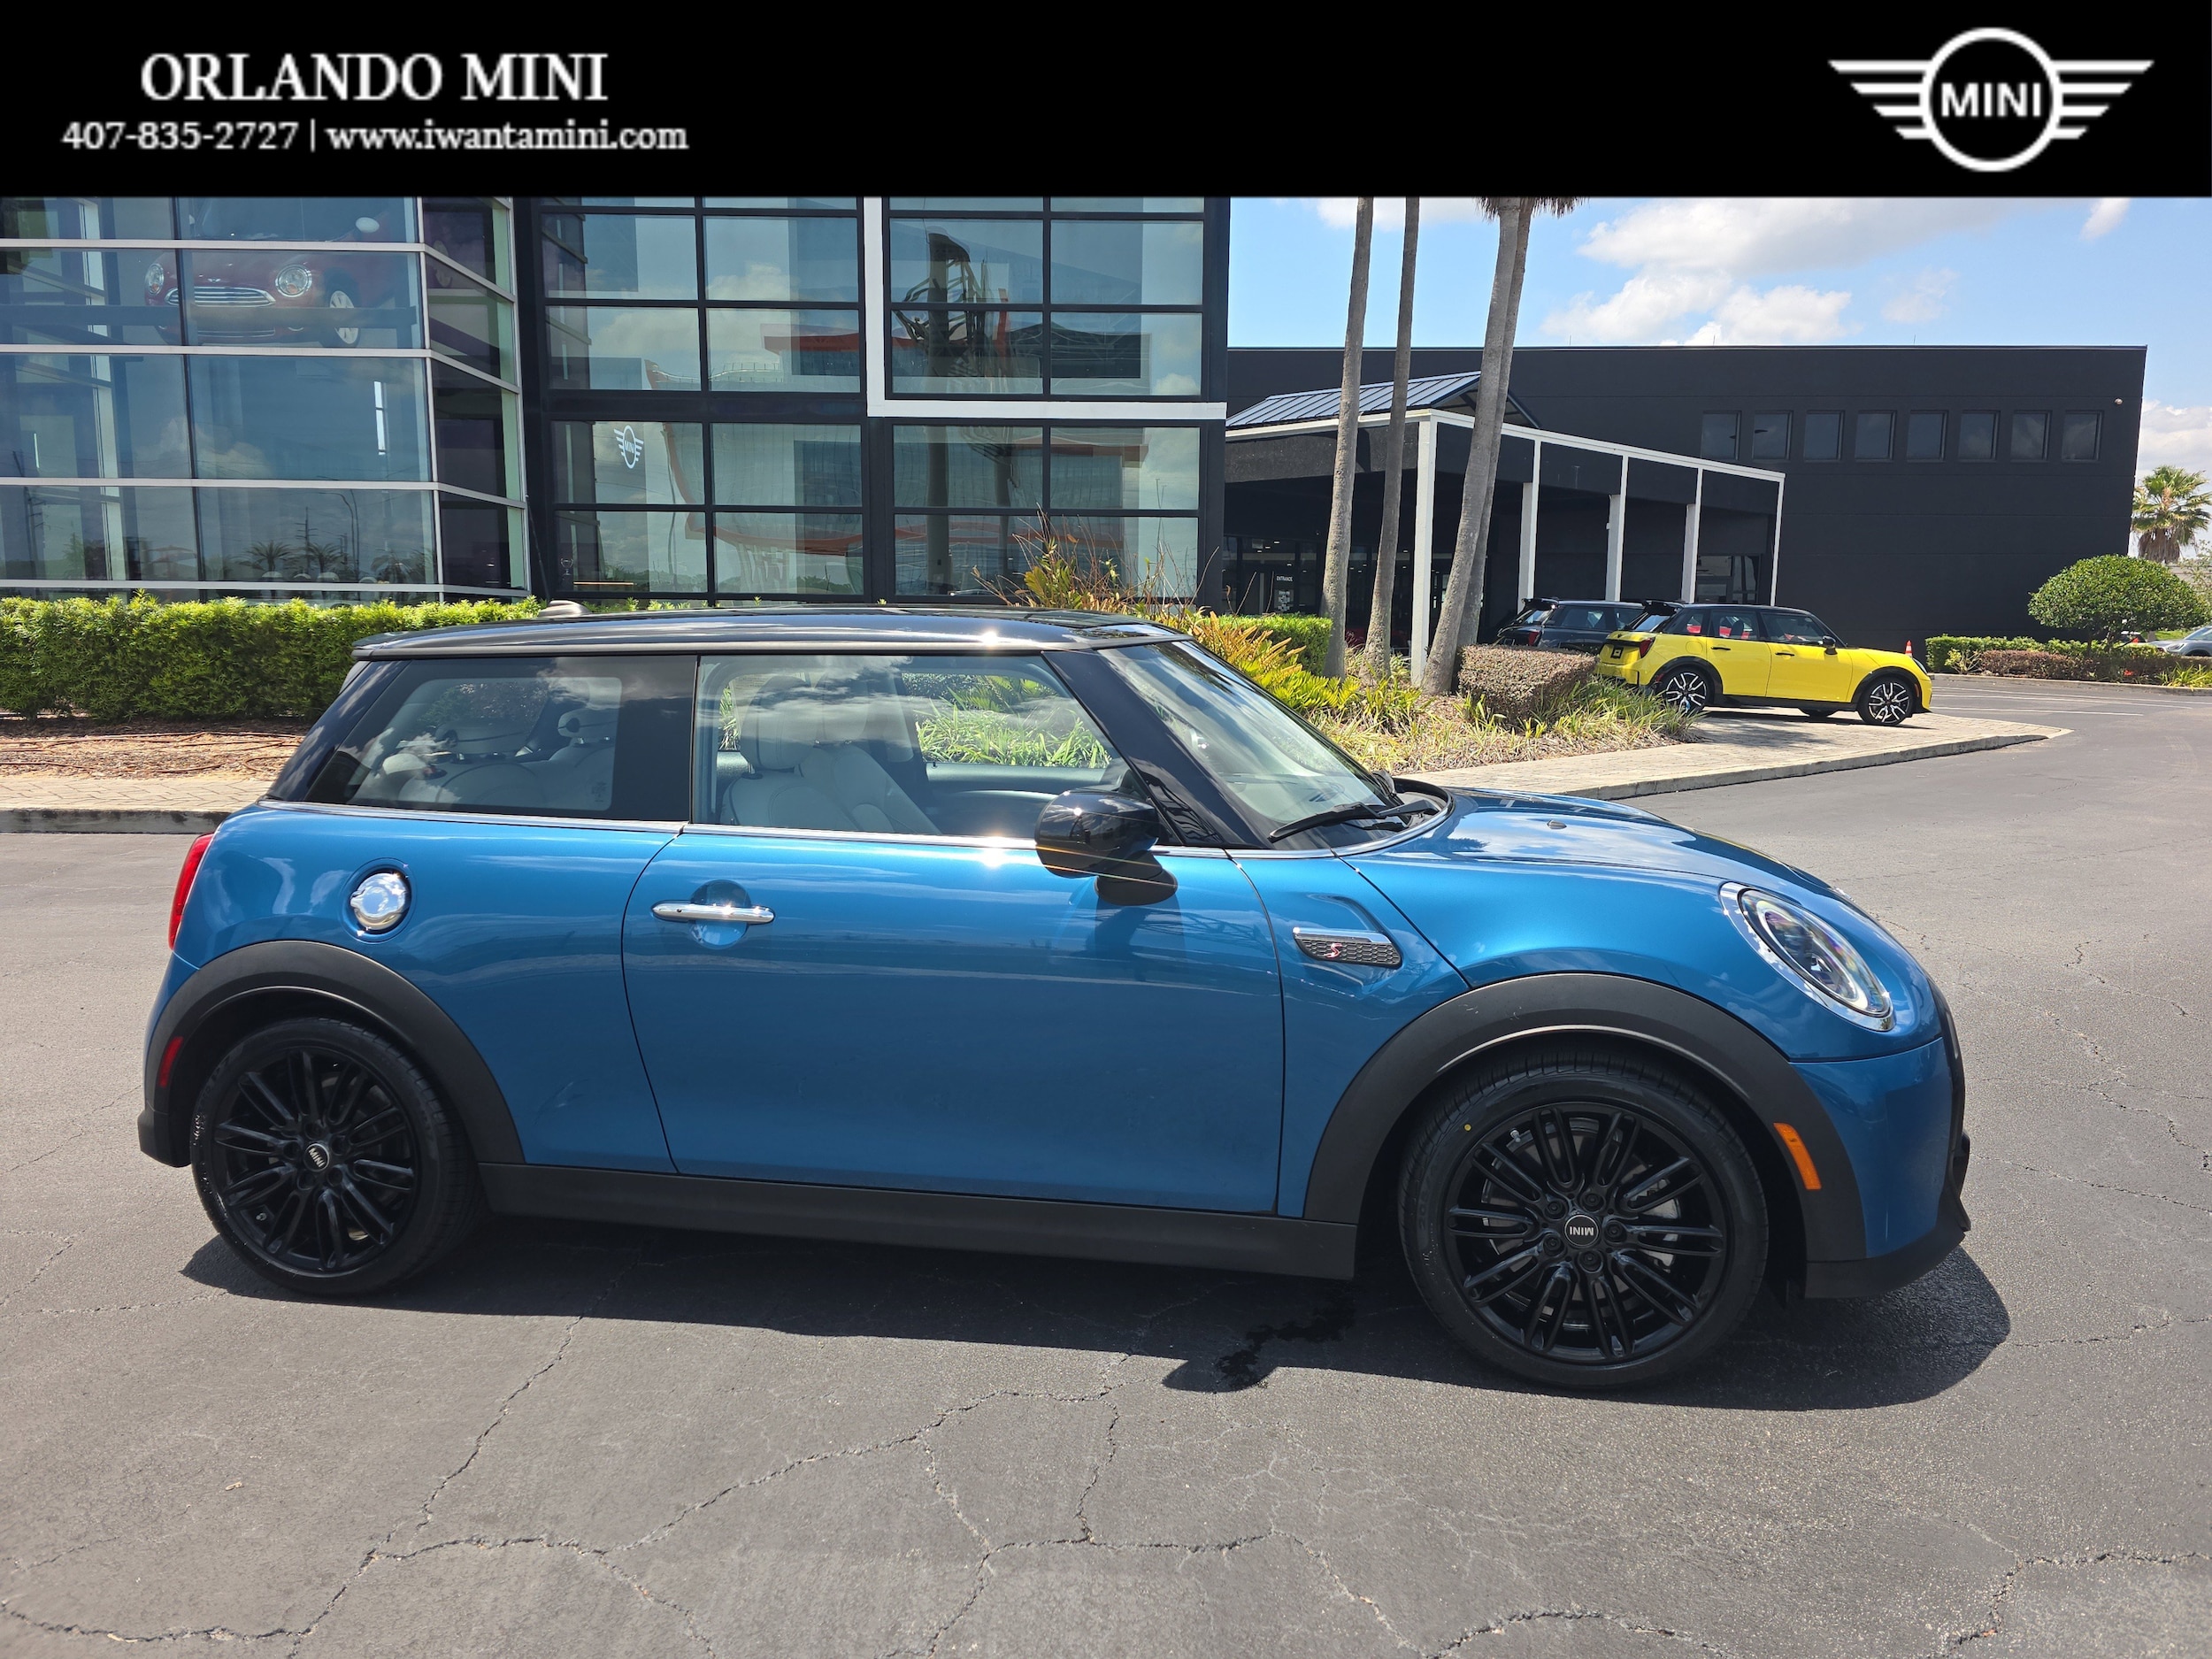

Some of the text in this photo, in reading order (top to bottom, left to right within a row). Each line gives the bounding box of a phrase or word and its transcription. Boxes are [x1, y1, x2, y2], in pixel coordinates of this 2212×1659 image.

[1323, 942, 1343, 959] S
[309, 1147, 326, 1168] MINI
[1569, 1225, 1594, 1236] MINI
